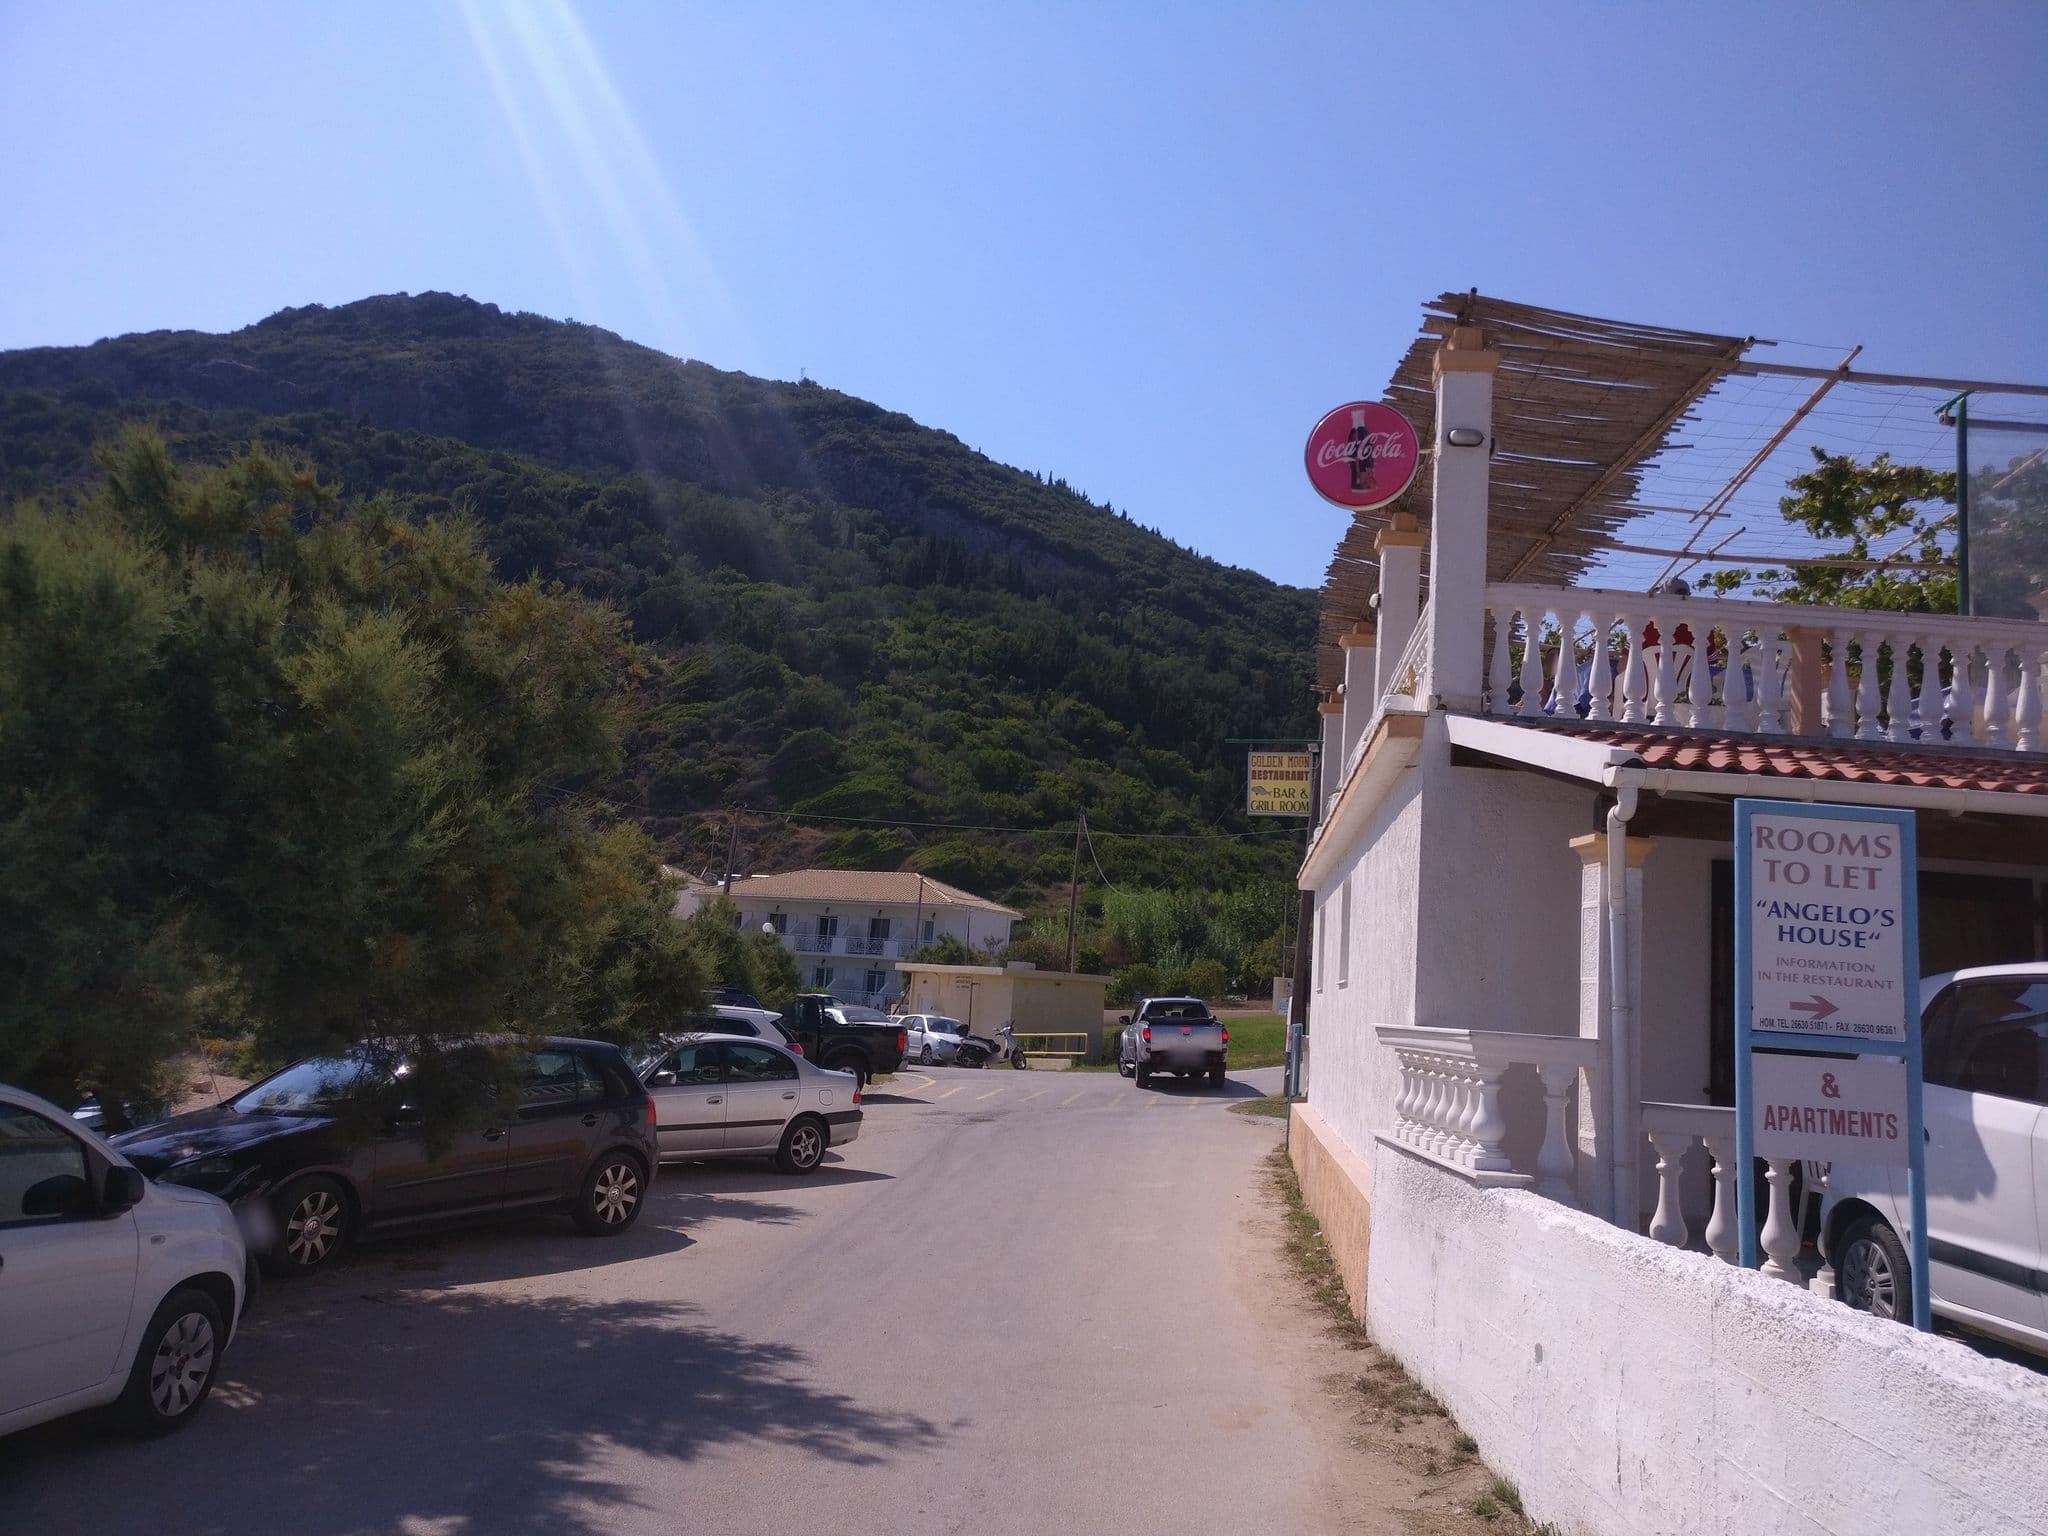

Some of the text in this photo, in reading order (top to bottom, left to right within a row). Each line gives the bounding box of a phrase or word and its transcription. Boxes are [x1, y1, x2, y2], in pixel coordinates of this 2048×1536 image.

[1251, 755, 1310, 768] GOLDEN MOON
[1251, 770, 1310, 781] RESTAURANT
[1273, 787, 1309, 799] BAR &
[1250, 800, 1309, 812] GRILL ROOM
[1755, 825, 1893, 860] ROOMS
[1762, 858, 1883, 891] TO LET
[1776, 956, 1876, 973] INFORMATION
[1757, 970, 1895, 990] IN THE RESTAURANT
[1821, 1072, 1841, 1099] &
[1763, 1104, 1899, 1140] APARTMENTS
